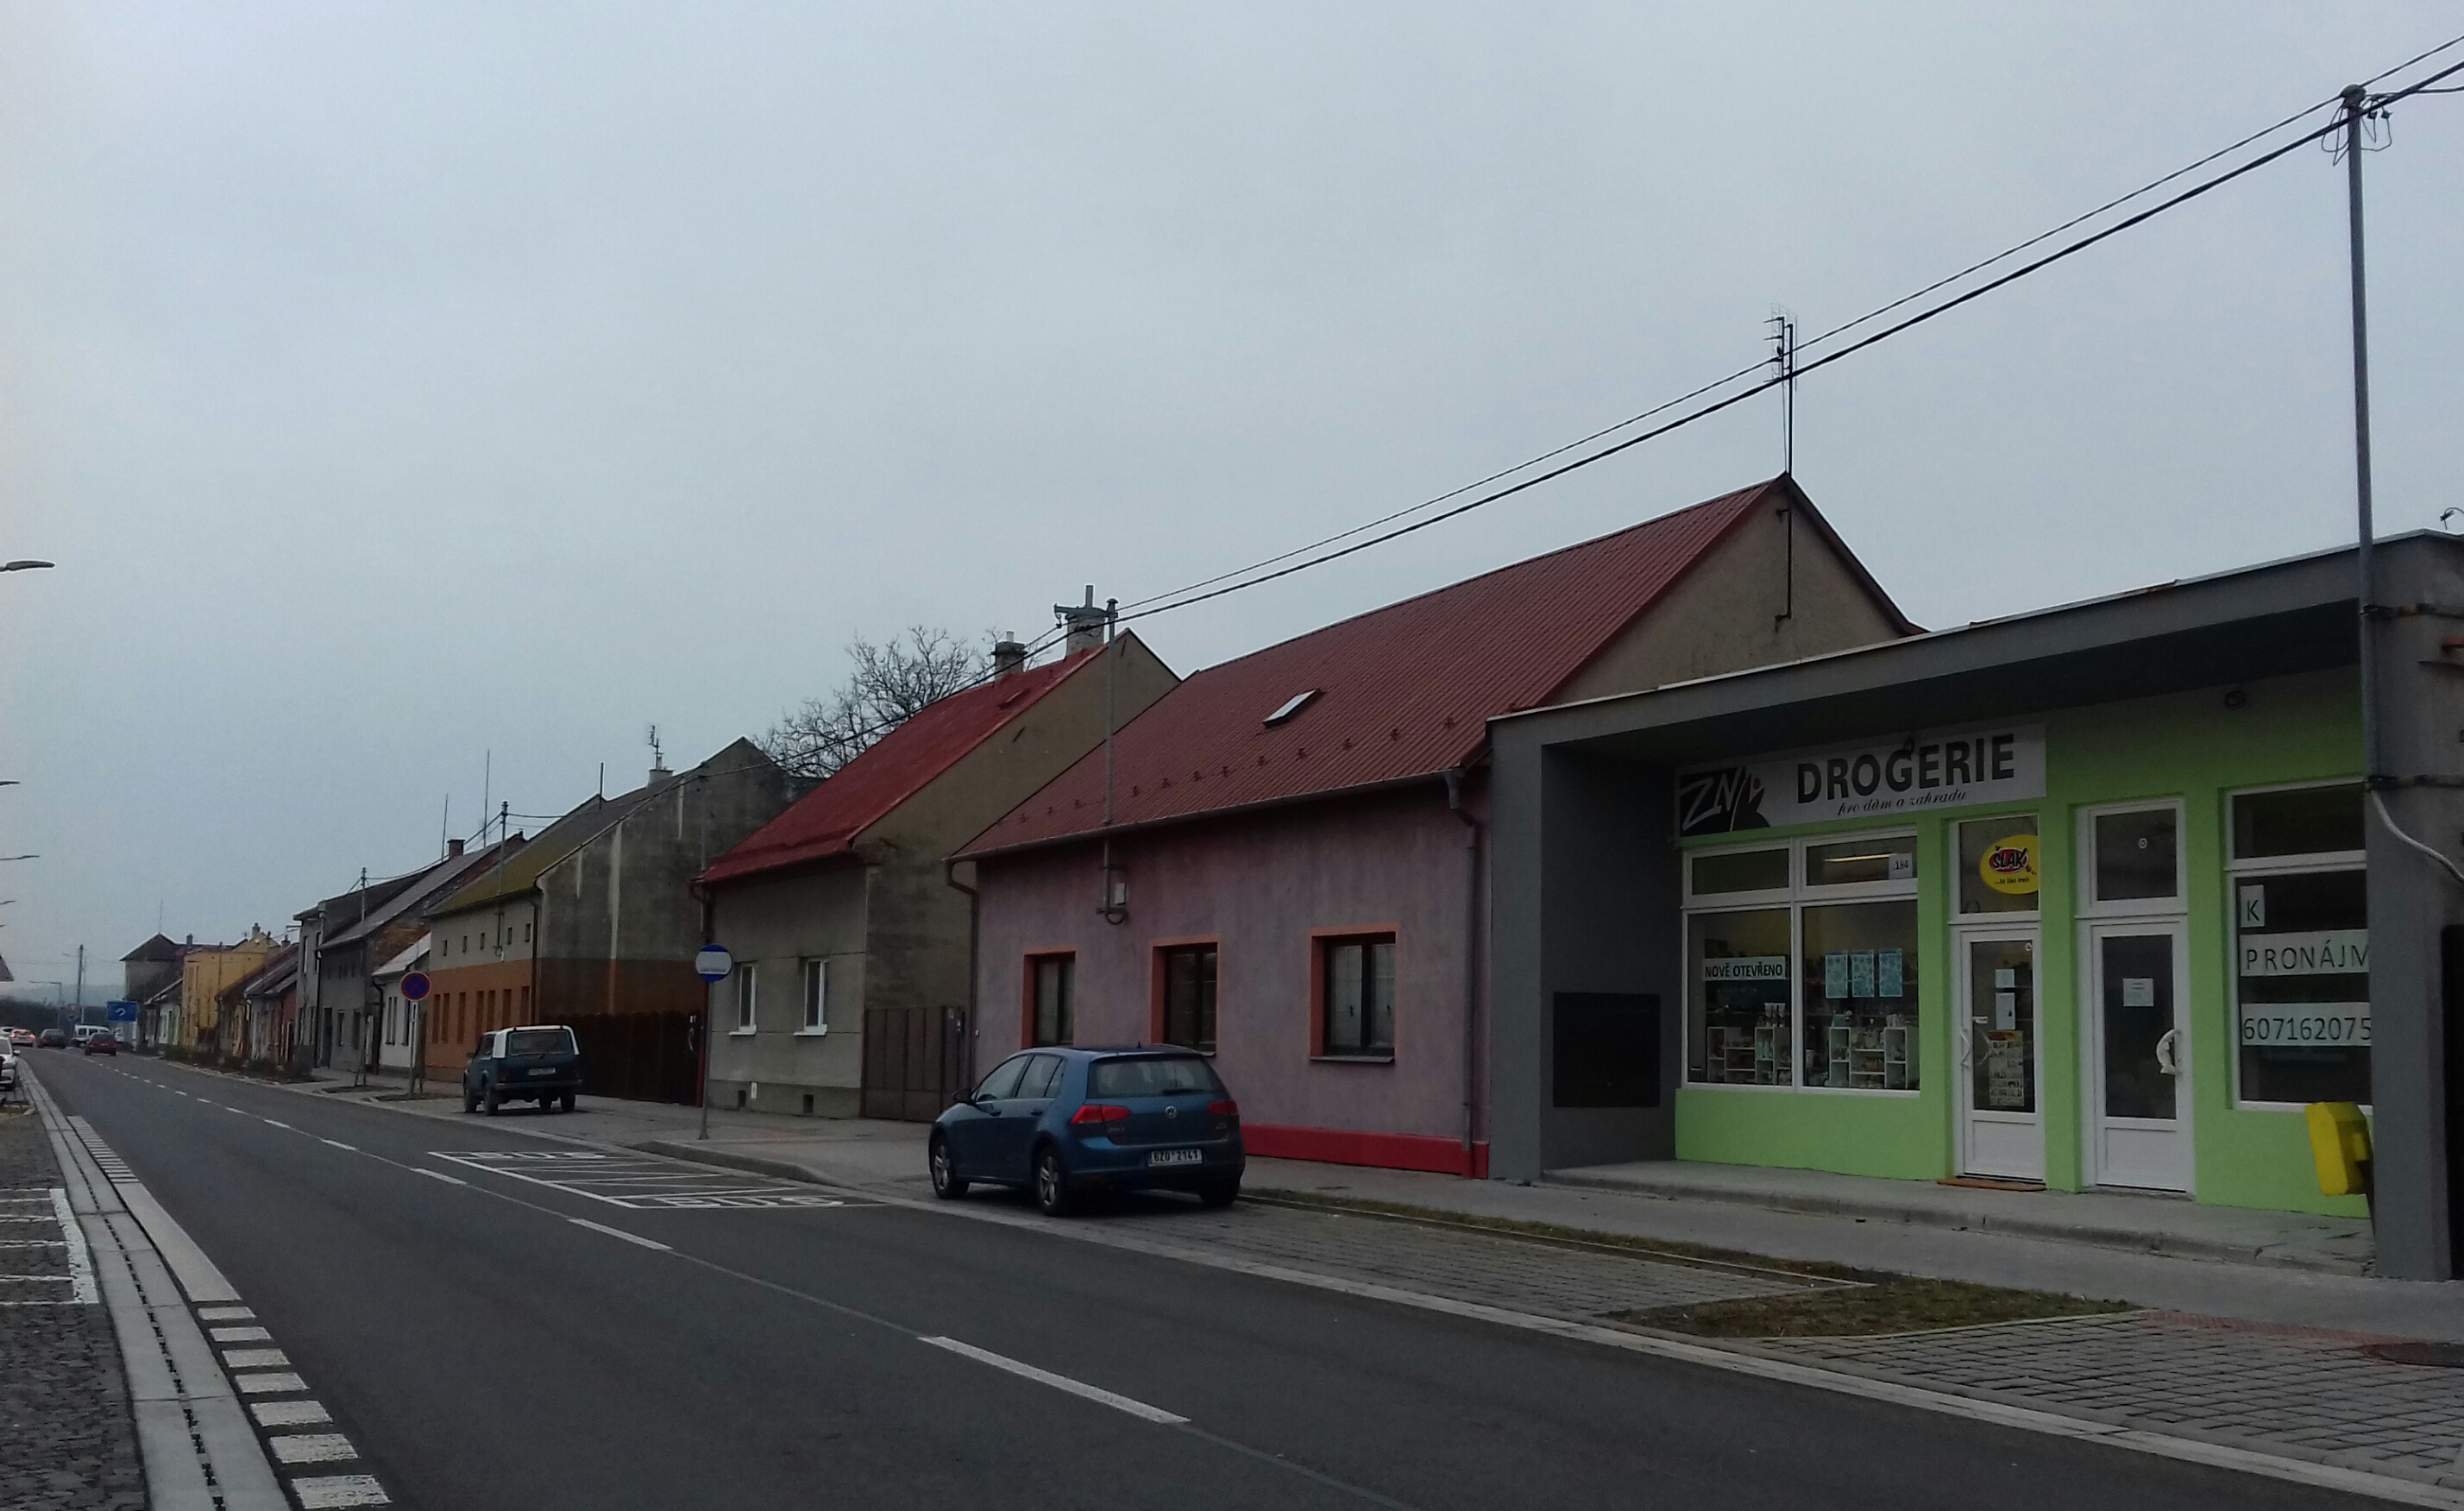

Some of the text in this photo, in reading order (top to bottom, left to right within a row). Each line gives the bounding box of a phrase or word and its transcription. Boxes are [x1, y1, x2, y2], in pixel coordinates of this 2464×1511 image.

[1797, 733, 2015, 804] DROGERIE
[1837, 789, 1966, 816] pro dům a zahradu
[1993, 845, 2027, 868] ŠLAK
[2247, 900, 2260, 922] K
[1705, 961, 1783, 978] NOVĚ OTEVŘENO
[2242, 1017, 2372, 1041] 607162075
[654, 1197, 844, 1207] BUS
